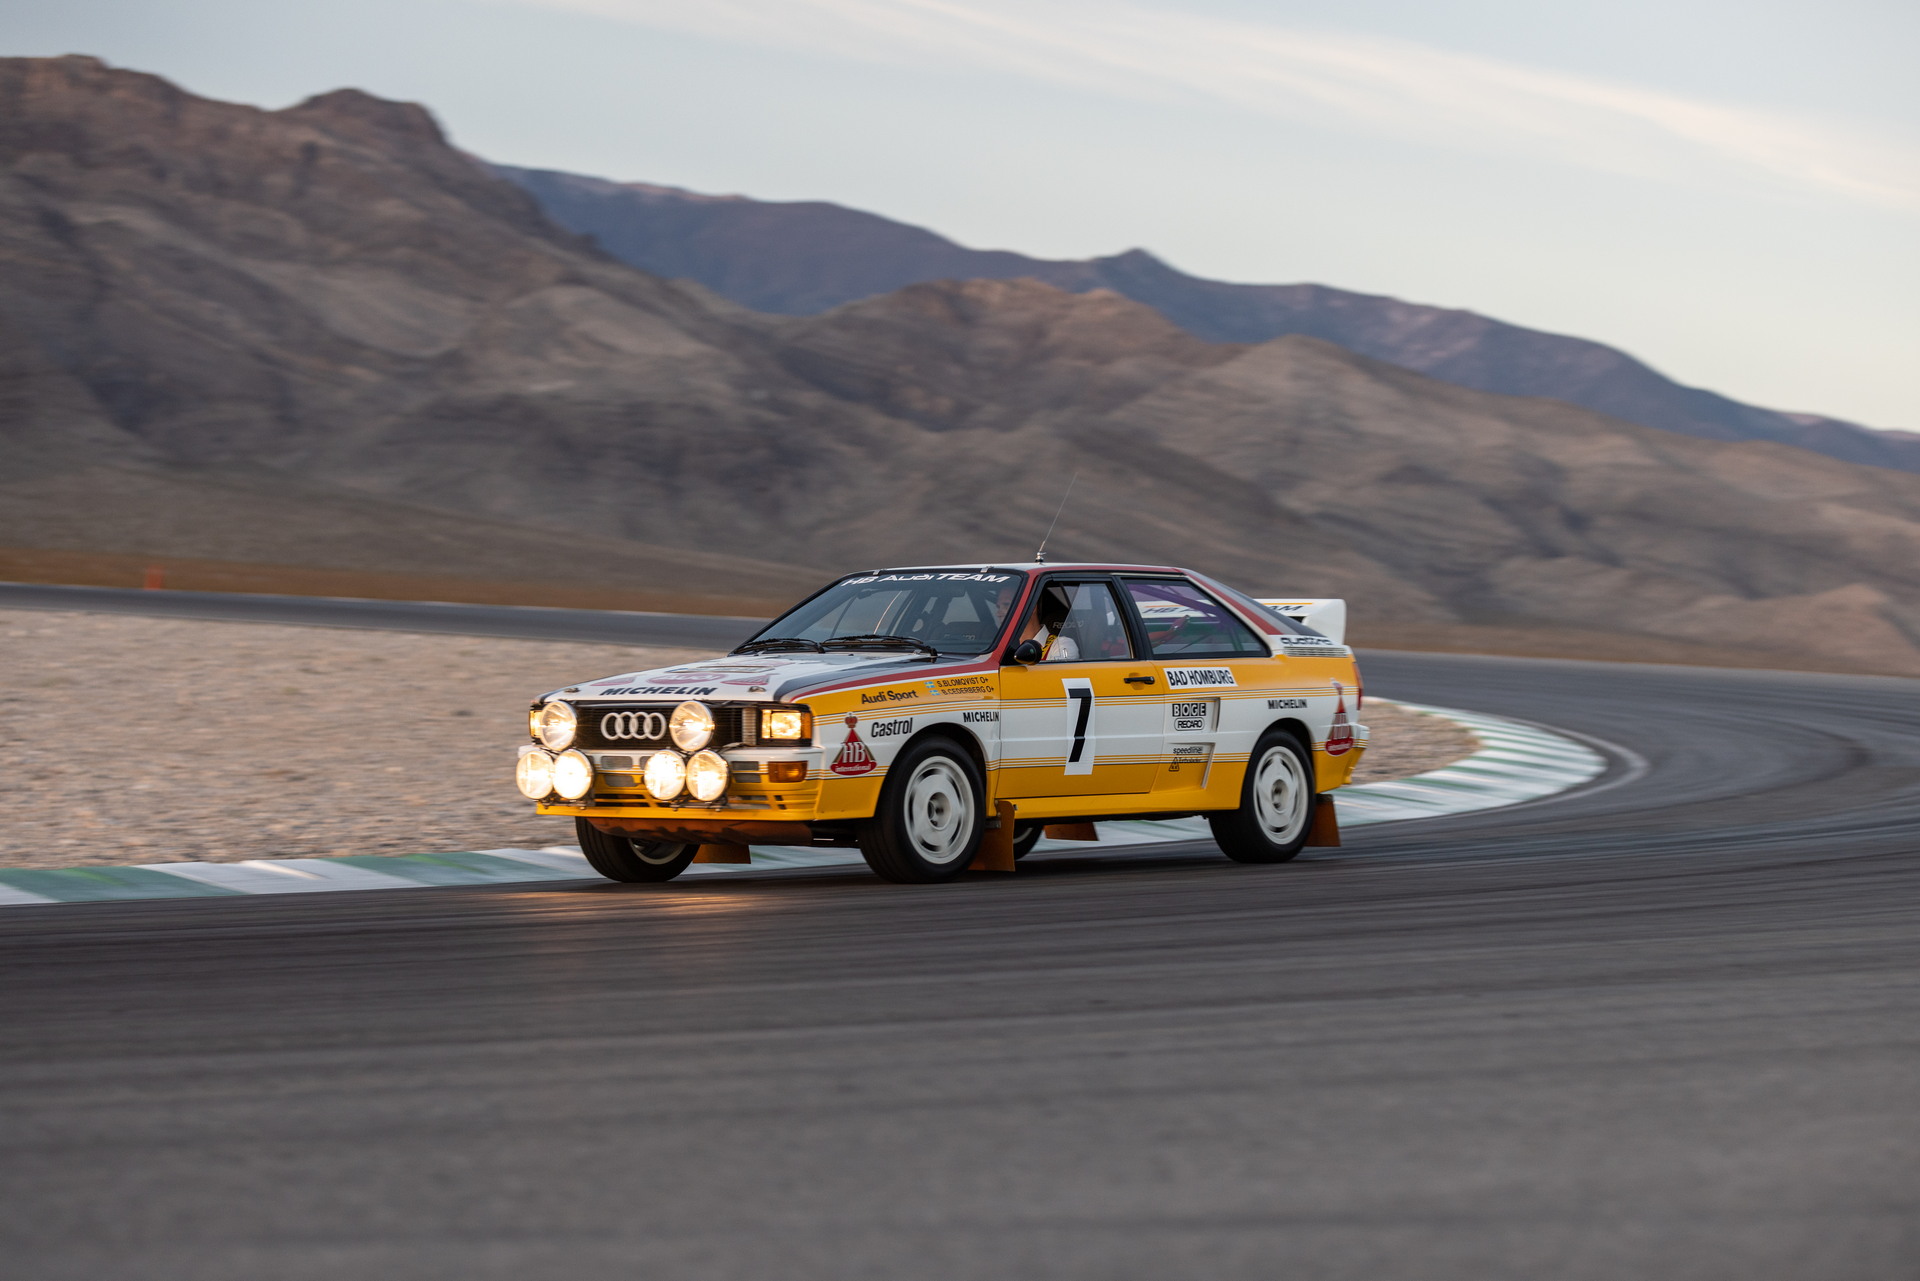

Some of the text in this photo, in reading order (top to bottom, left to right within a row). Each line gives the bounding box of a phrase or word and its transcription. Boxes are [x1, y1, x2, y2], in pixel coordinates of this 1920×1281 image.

[841, 577, 877, 586] HB
[936, 573, 1010, 583] TEAM
[1167, 670, 1234, 686] BAD HOMBURG
[599, 686, 718, 696] MICHELIN
[861, 689, 919, 704] Audi Sport
[1172, 703, 1206, 717] BOGE
[1267, 699, 1308, 709] MICHELIN
[963, 711, 999, 723] MICHELIN
[871, 717, 913, 738] Castrol
[1068, 688, 1092, 762] 7
[1177, 720, 1203, 729] RECARO
[842, 742, 866, 763] HB
